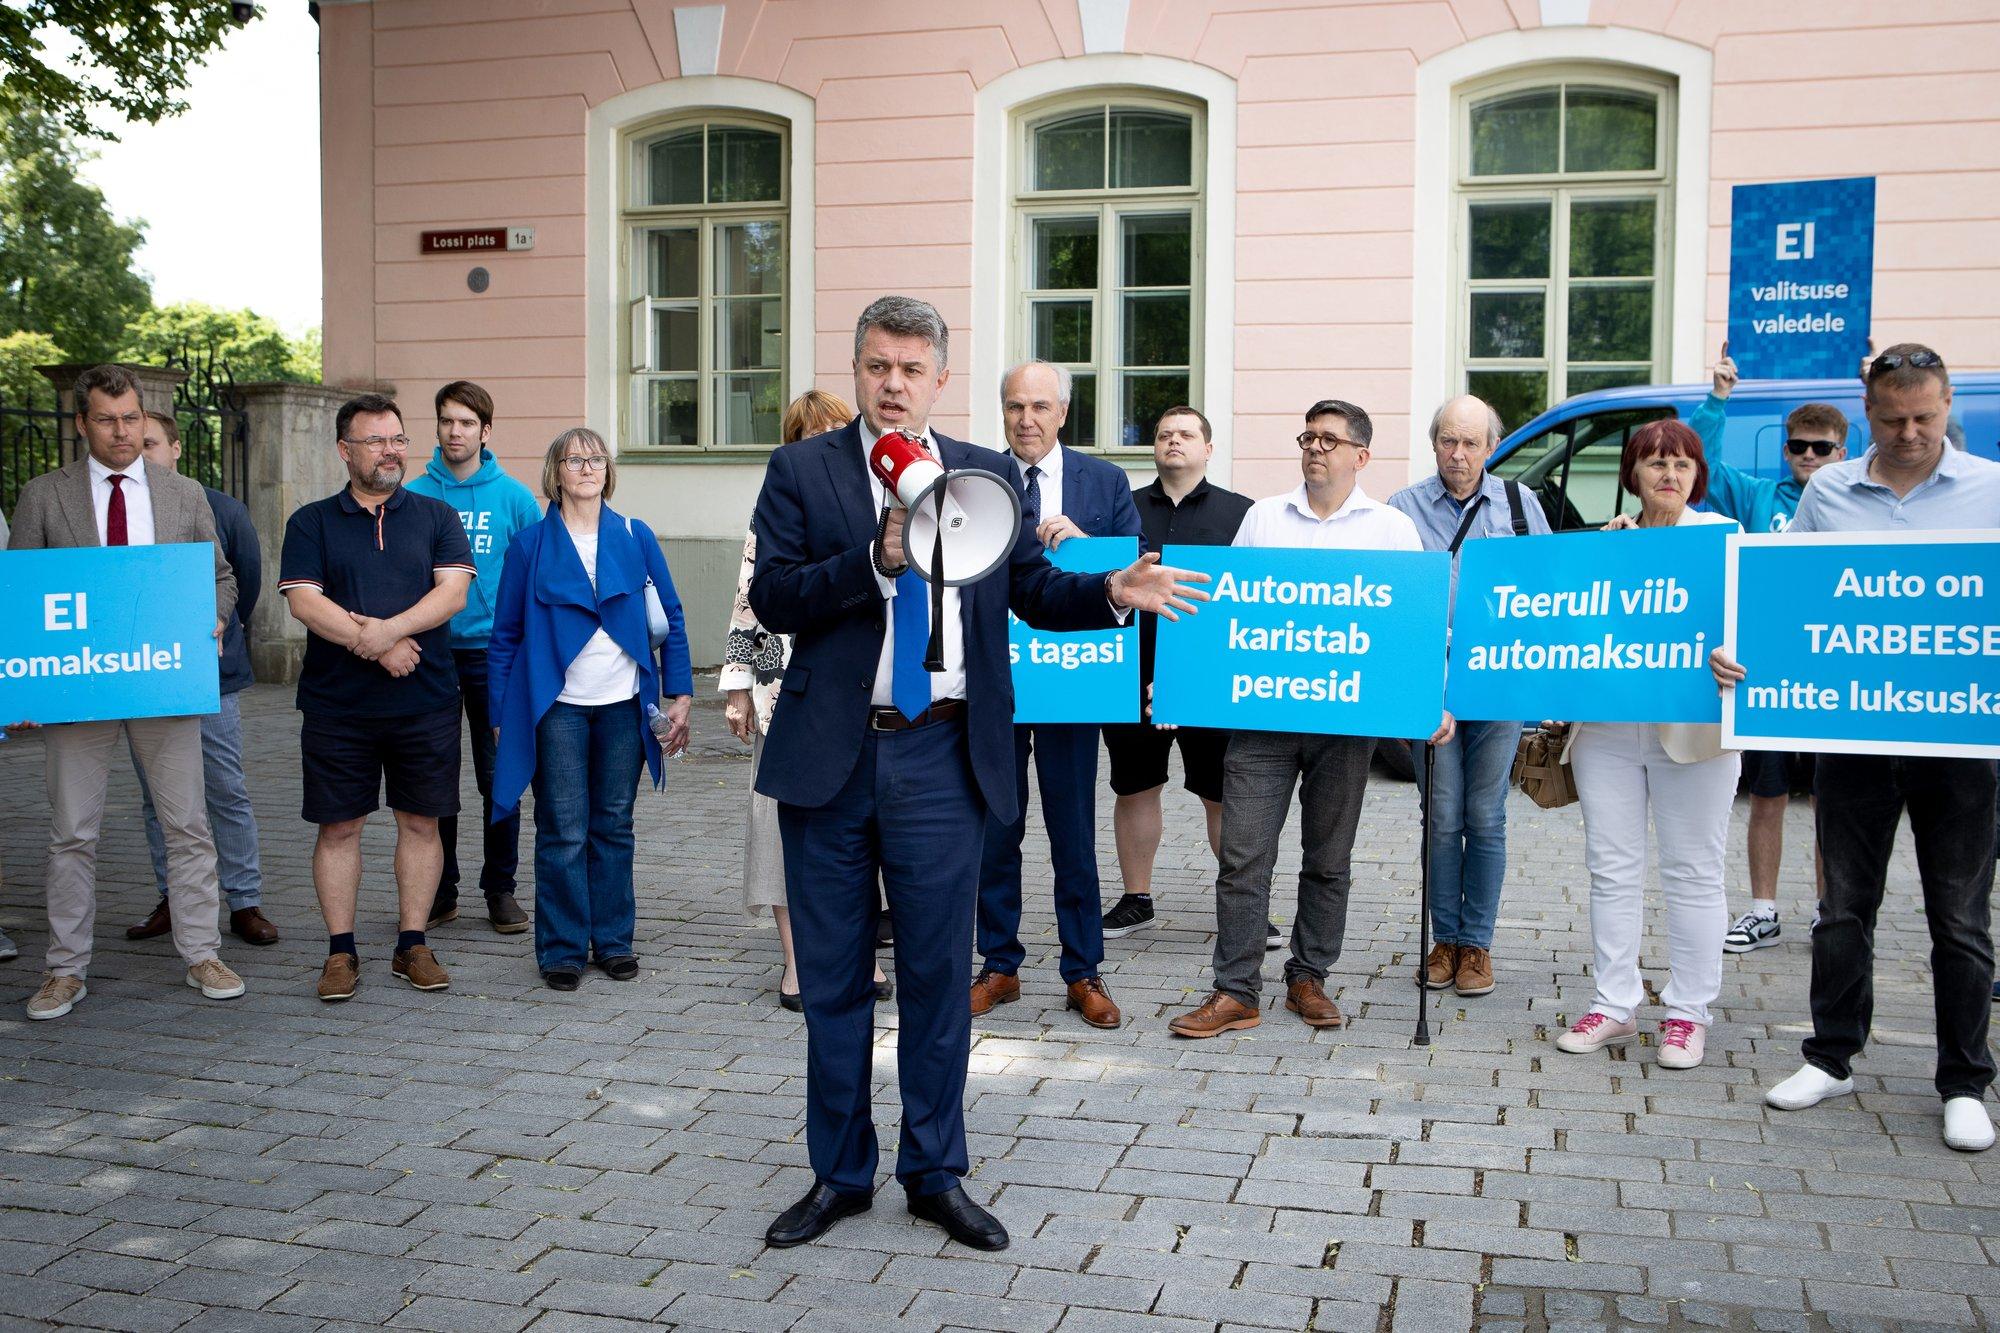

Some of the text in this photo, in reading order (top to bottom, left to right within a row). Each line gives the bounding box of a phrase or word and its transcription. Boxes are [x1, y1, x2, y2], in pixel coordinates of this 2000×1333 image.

[433, 233, 527, 249] Lossi plats 1a
[1776, 222, 1815, 260] EI
[1751, 281, 1849, 301] valitsuse
[1752, 313, 1845, 334] valedele
[1212, 572, 1392, 607] Automaks
[1493, 578, 1689, 618] Teerull viib
[1834, 568, 1984, 597] Auto on
[44, 592, 88, 631] EI
[1029, 634, 1124, 669] tagasi
[1228, 618, 1370, 655] karistab
[1468, 632, 1705, 670] automaksuni
[1804, 624, 2000, 656] TARBEESE
[1232, 670, 1361, 703] peresid
[1747, 679, 1840, 710] mitte
